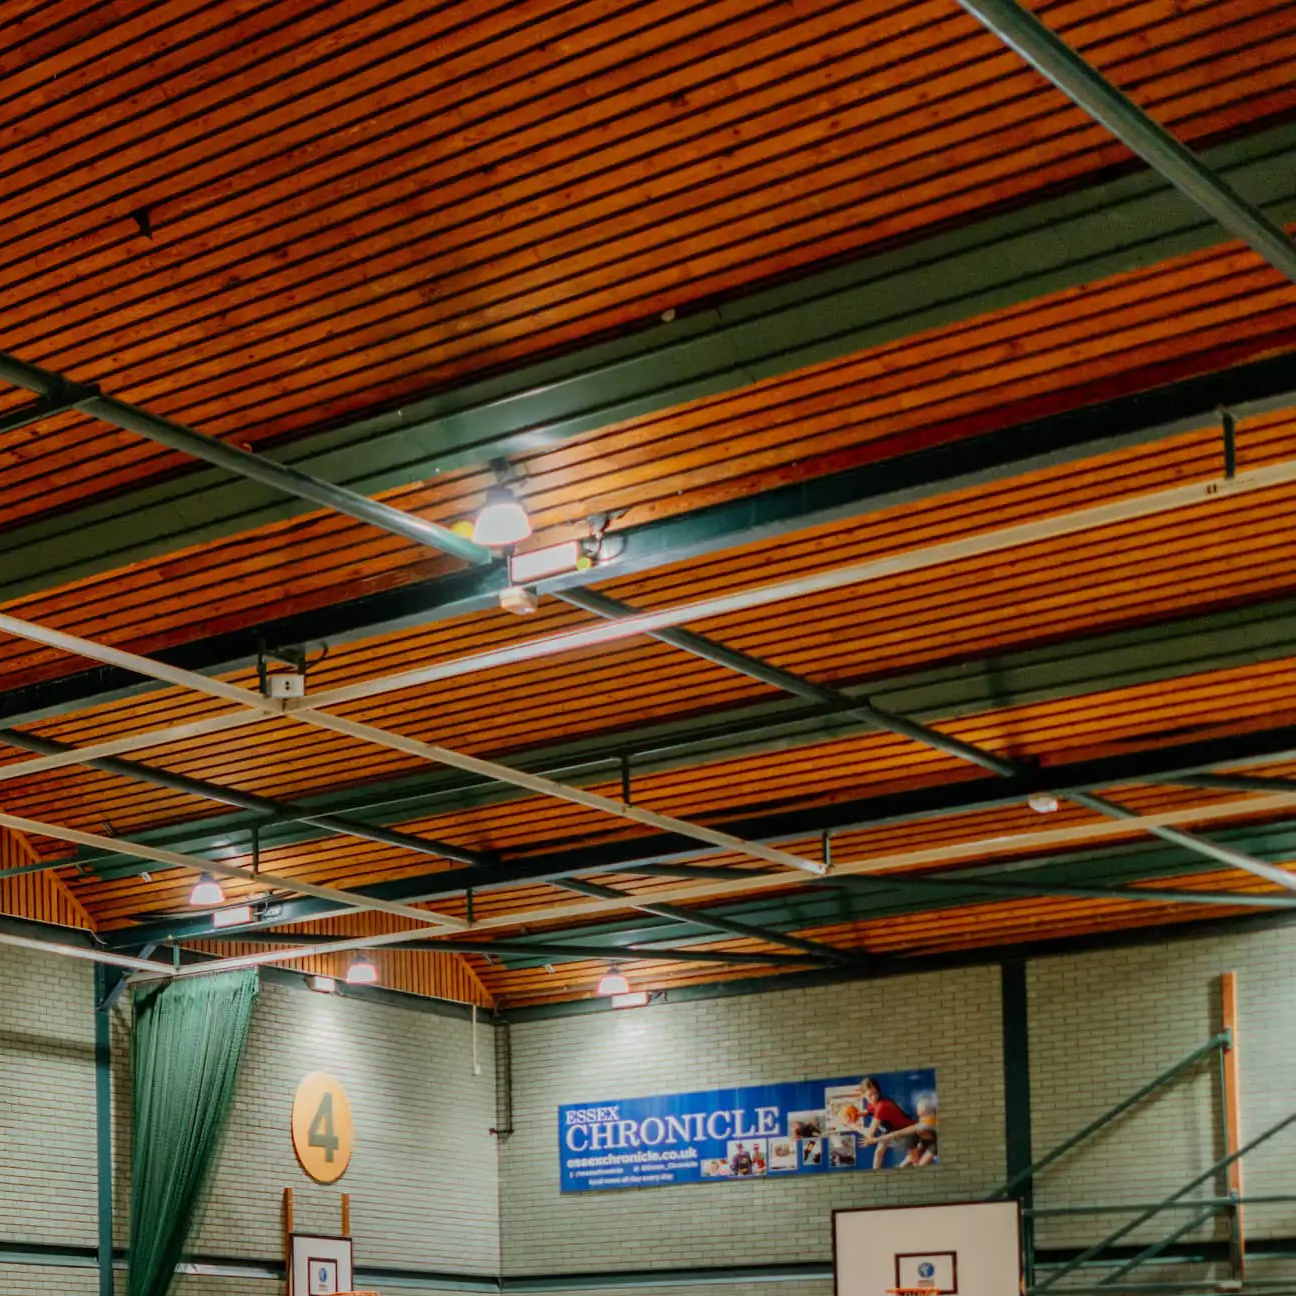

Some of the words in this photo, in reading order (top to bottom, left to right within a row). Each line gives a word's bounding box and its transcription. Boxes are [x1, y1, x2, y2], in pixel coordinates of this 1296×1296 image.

[308, 1091, 339, 1163] 4
[565, 1106, 620, 1125] ESSEX
[566, 1106, 780, 1151] CHRONICLE
